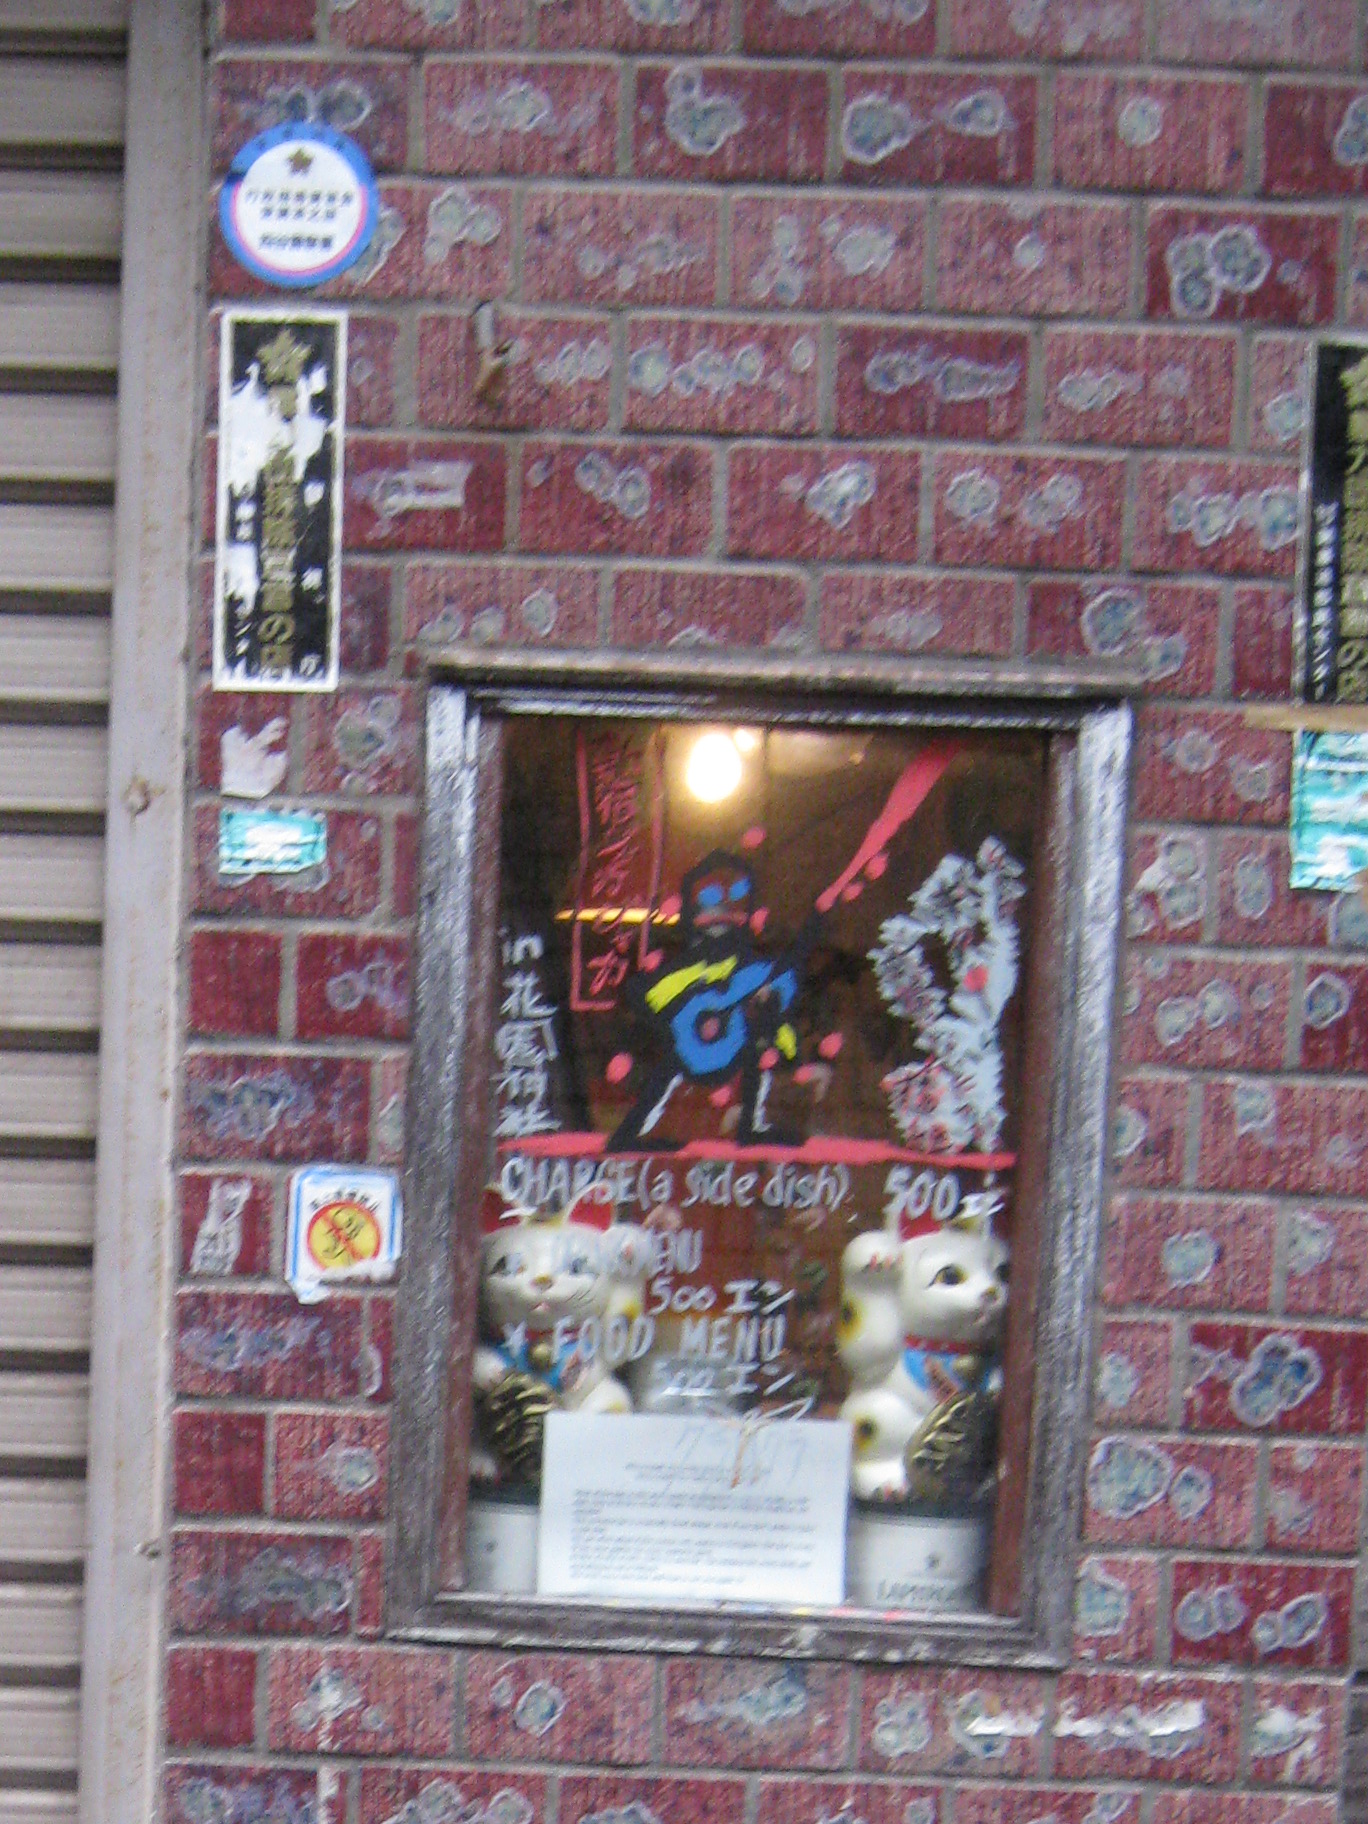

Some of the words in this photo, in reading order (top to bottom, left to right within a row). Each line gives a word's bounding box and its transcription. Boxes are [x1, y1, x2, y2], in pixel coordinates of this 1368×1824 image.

[500, 927, 543, 966] in
[494, 970, 560, 1138] 花園神社
[550, 1314, 656, 1363] FOOD
[680, 1312, 788, 1364] MENU
